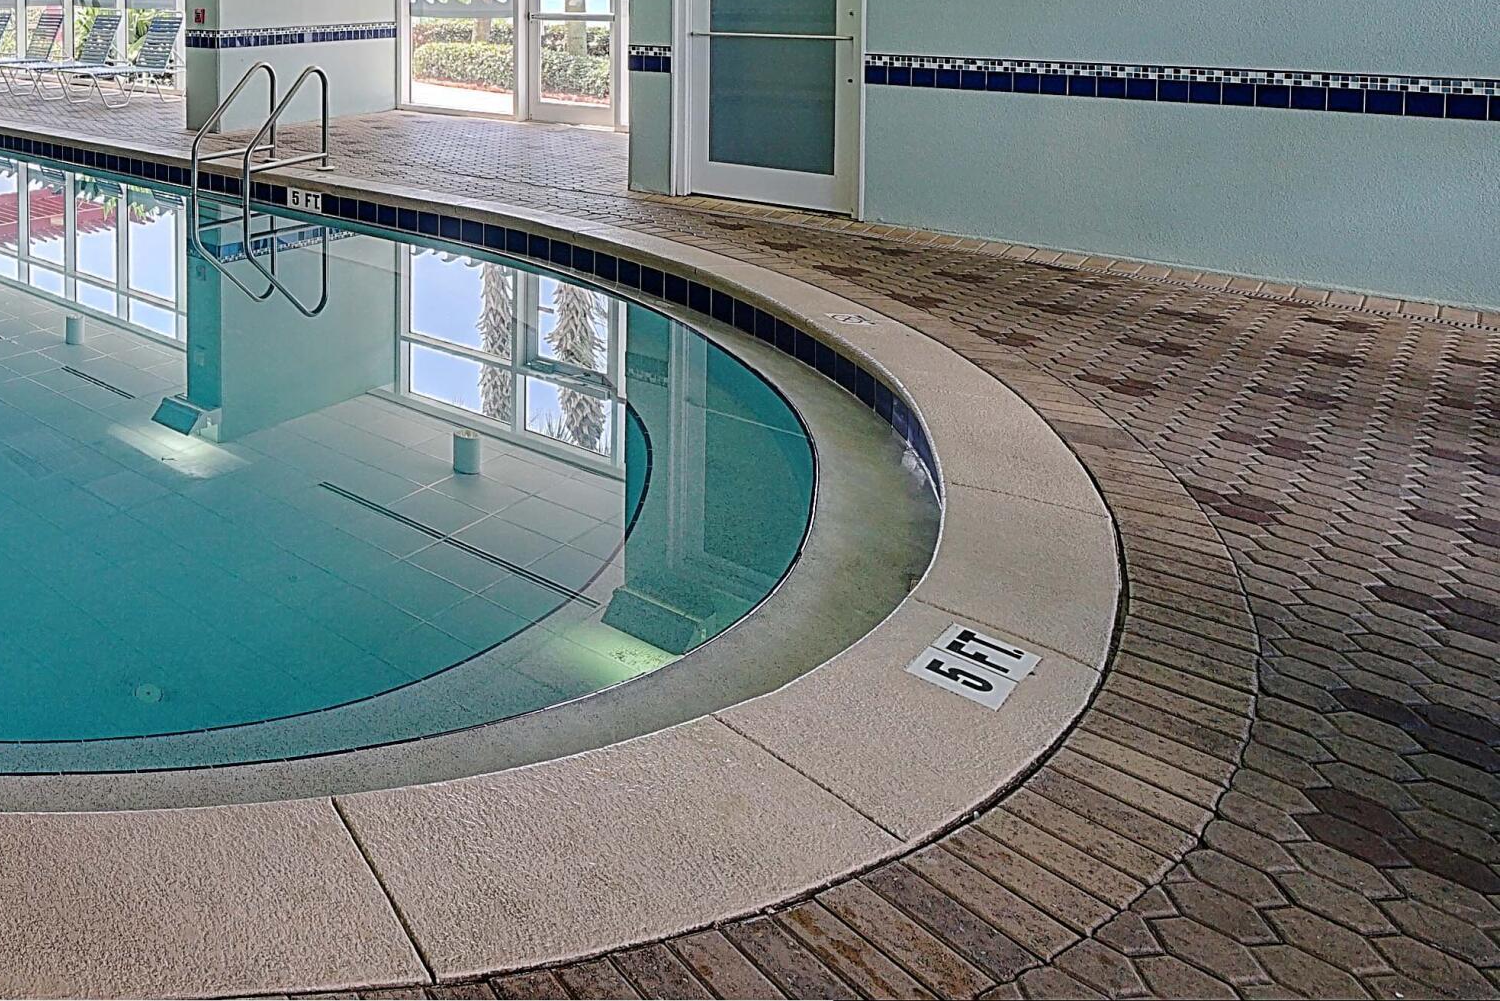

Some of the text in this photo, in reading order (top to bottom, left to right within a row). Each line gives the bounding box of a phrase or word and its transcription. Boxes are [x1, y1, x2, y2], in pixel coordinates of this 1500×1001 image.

[292, 190, 300, 206] 5
[925, 629, 1026, 692] 5 FT.
